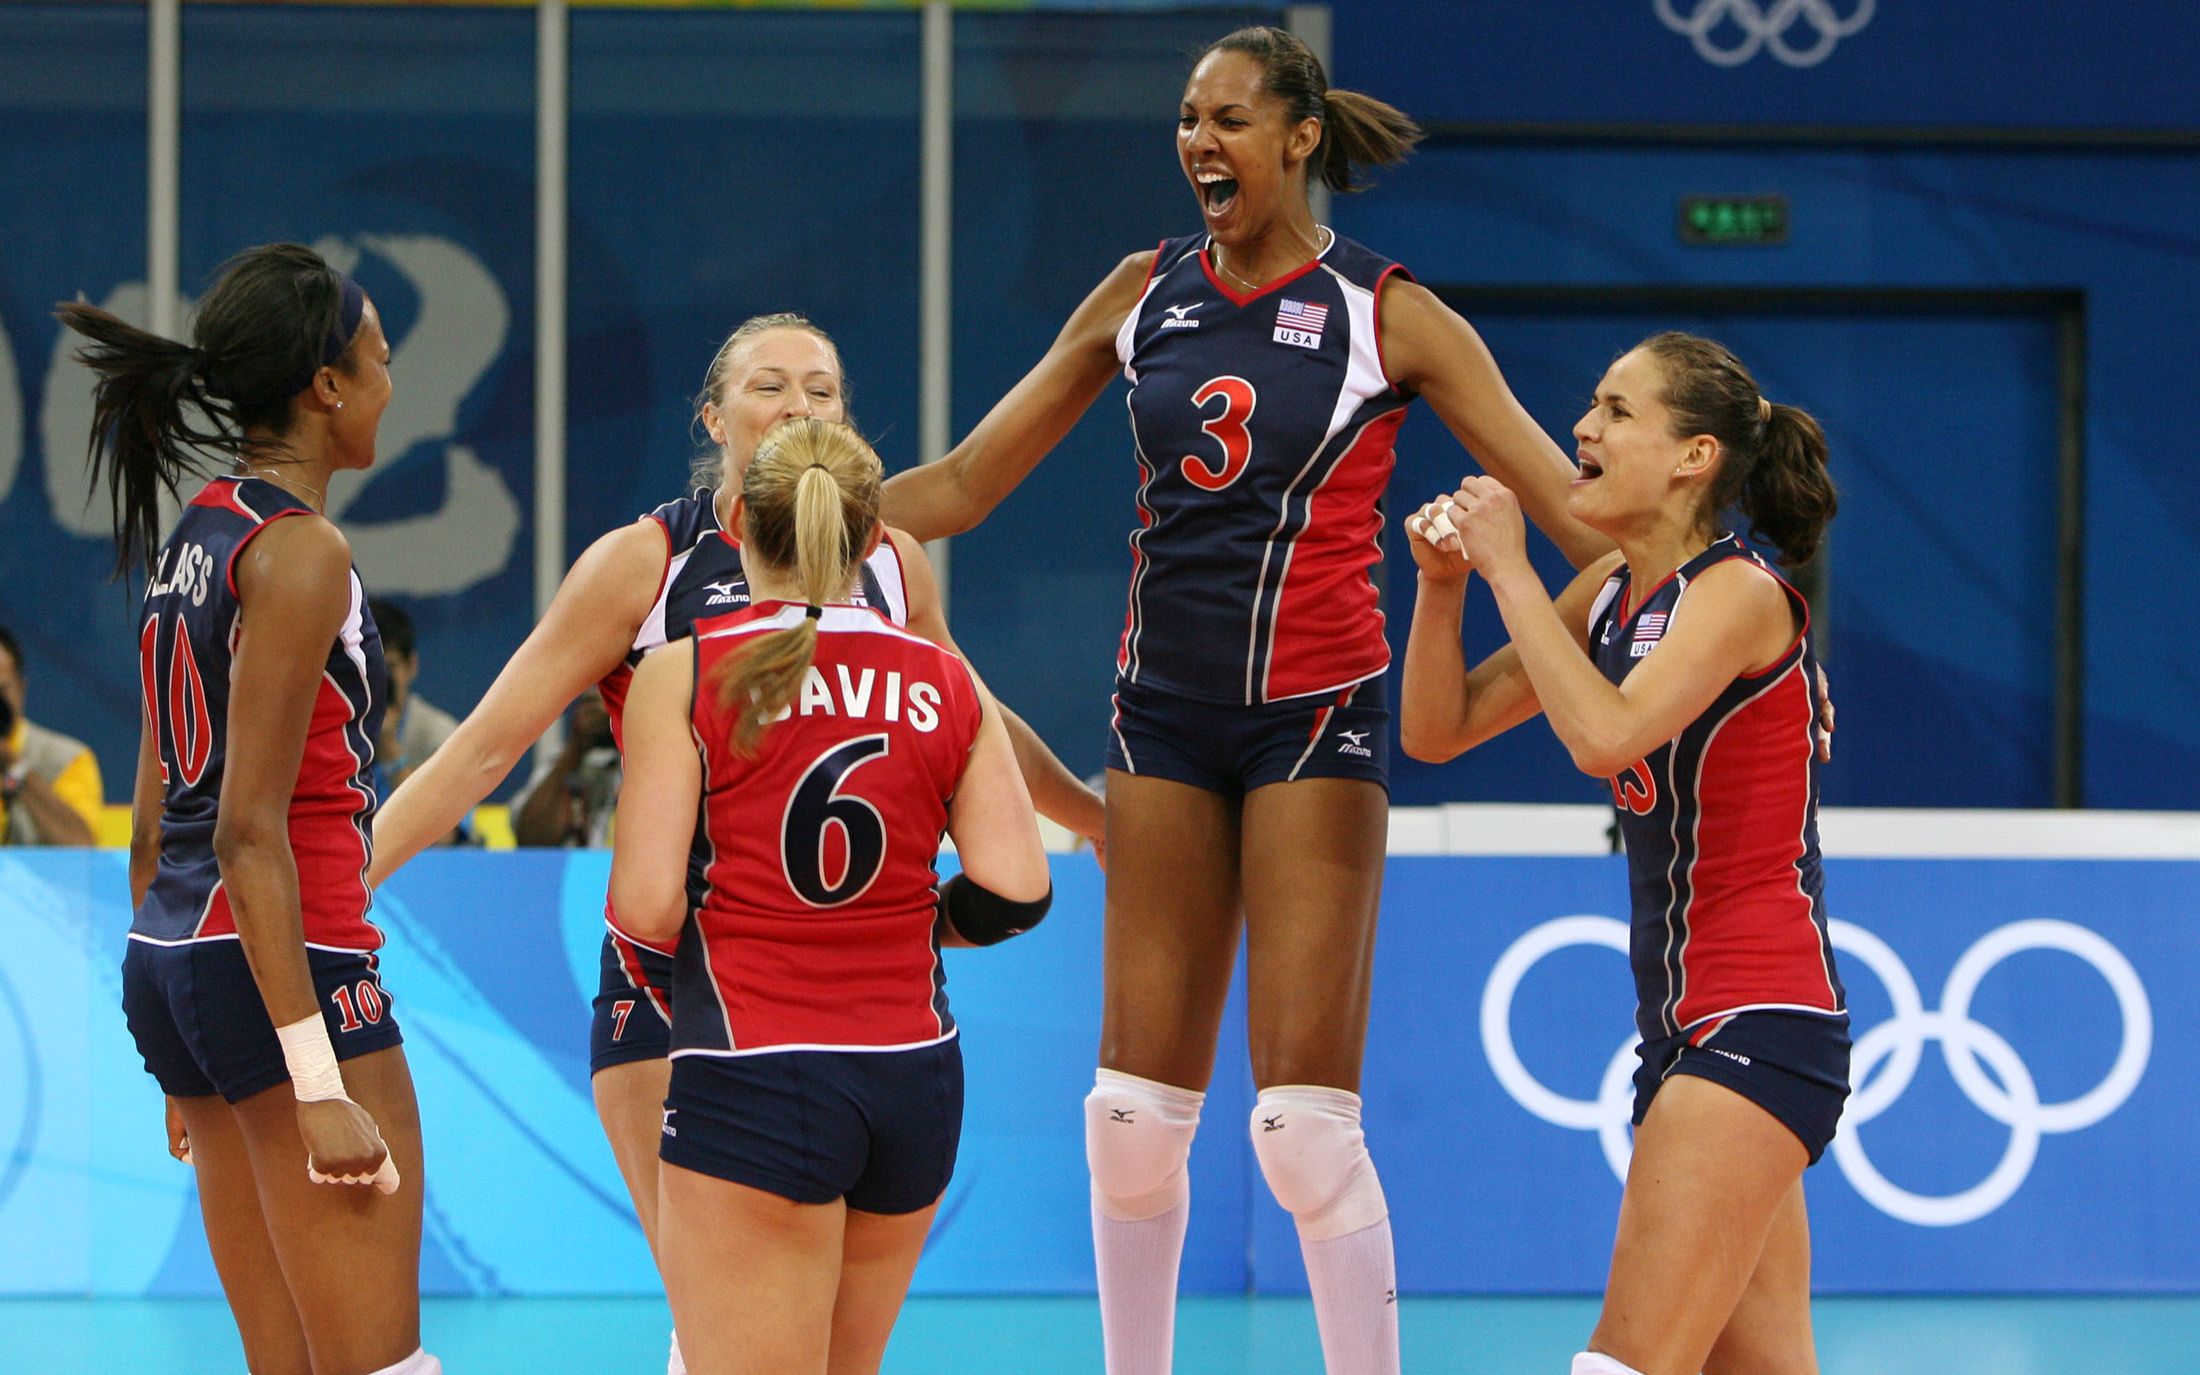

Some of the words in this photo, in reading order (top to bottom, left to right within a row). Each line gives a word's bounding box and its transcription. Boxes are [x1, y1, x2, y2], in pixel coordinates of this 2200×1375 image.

[1280, 330, 1312, 346] USA
[1181, 375, 1257, 491] 3
[705, 594, 750, 606] MIZUNO
[140, 612, 212, 788] 10
[780, 733, 889, 909] 6
[331, 980, 383, 1032] 10
[611, 1000, 635, 1041] 7
